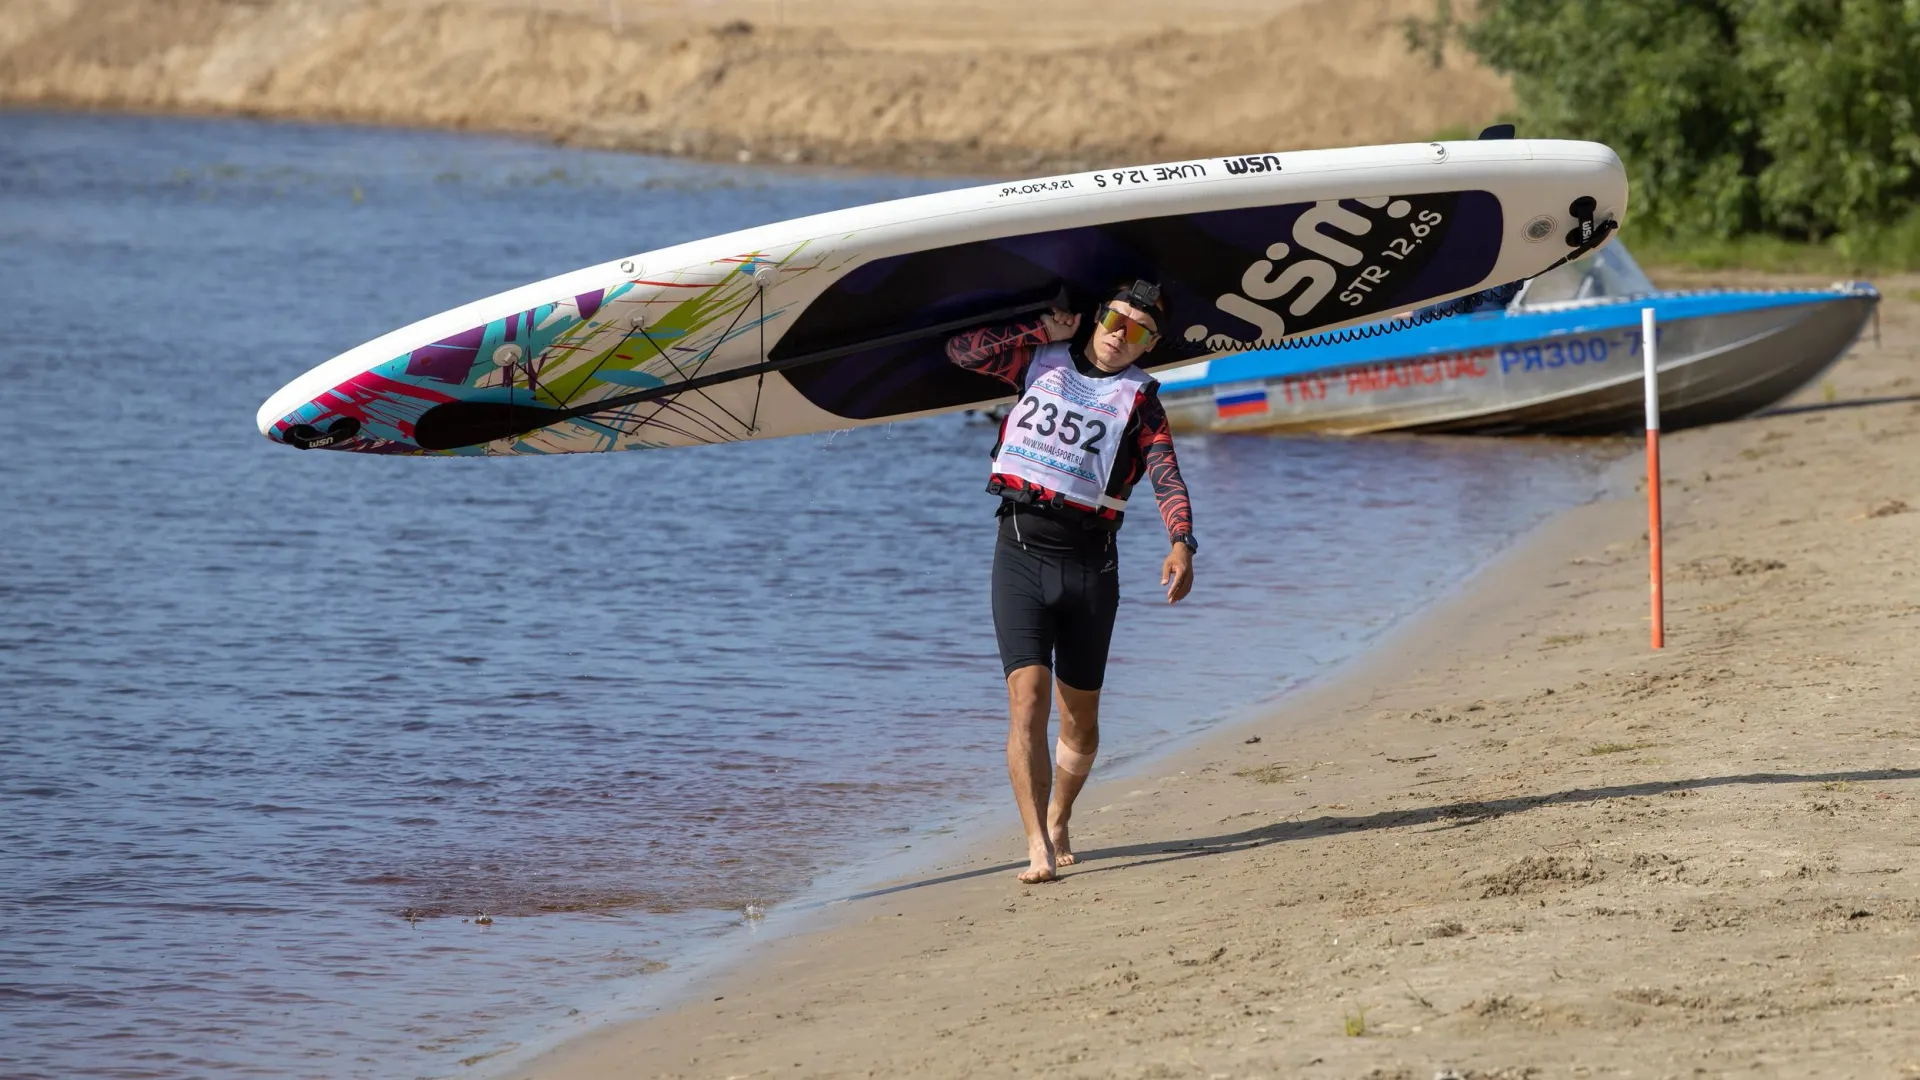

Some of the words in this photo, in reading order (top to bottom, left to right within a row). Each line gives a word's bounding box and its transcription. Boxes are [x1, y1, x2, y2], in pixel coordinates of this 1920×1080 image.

[1093, 174, 1107, 188] S
[1157, 163, 1207, 181] LUXE
[1339, 265, 1390, 306] STR
[1284, 374, 1327, 402] ГКУ
[1017, 396, 1107, 455] 2352
[1022, 436, 1084, 465] WWW.YAMAL-SPORT.RU
